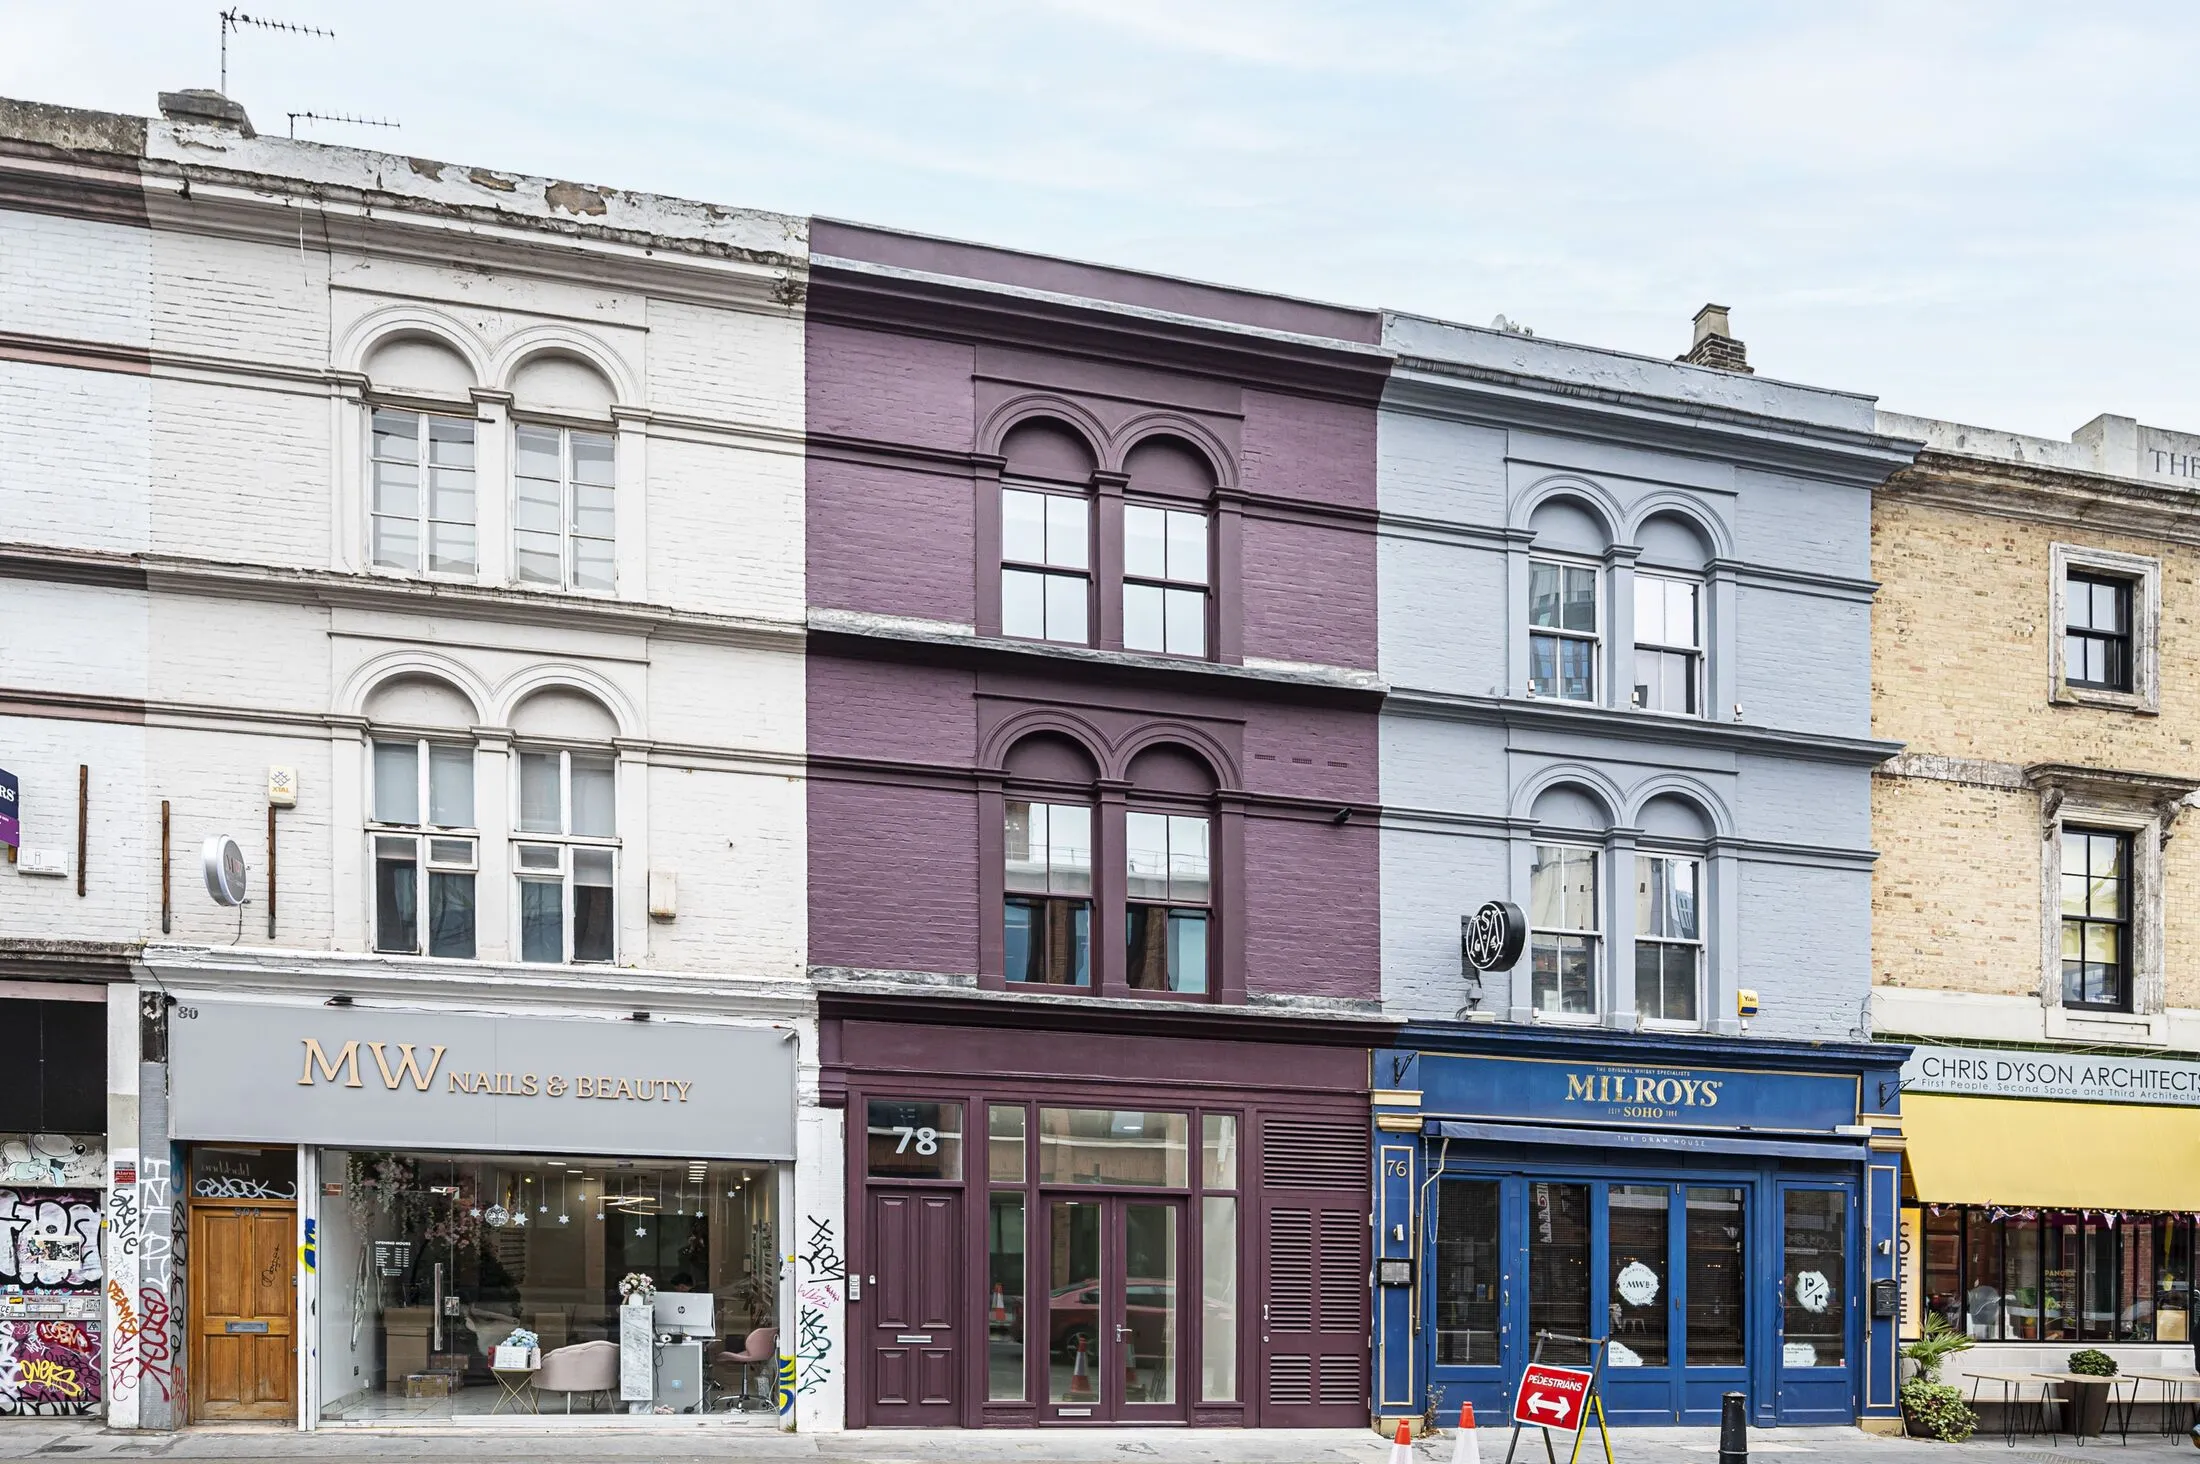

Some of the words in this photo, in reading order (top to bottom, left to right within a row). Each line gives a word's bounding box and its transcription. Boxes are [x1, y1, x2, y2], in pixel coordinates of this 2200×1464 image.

[178, 1006, 199, 1020] 80
[297, 1037, 447, 1092] MW
[448, 1071, 539, 1097] NAILS
[546, 1075, 569, 1098] &
[576, 1076, 693, 1103] BEAUTY
[1922, 1057, 1988, 1081] CHRIS
[1996, 1061, 2073, 1085] DYSON
[1921, 1078, 1945, 1088] First
[1997, 1082, 2038, 1093] Second
[2043, 1085, 2078, 1096] Space
[2083, 1088, 2104, 1096] and
[2109, 1088, 2135, 1098] Third
[1623, 1106, 1663, 1119] SOHO
[893, 1126, 937, 1155] 78
[1641, 1136, 1669, 1144] DRAM
[1673, 1139, 1705, 1147] HOUSE
[1387, 1160, 1406, 1177] 76
[1527, 1374, 1583, 1392] PEDESTRIANS
